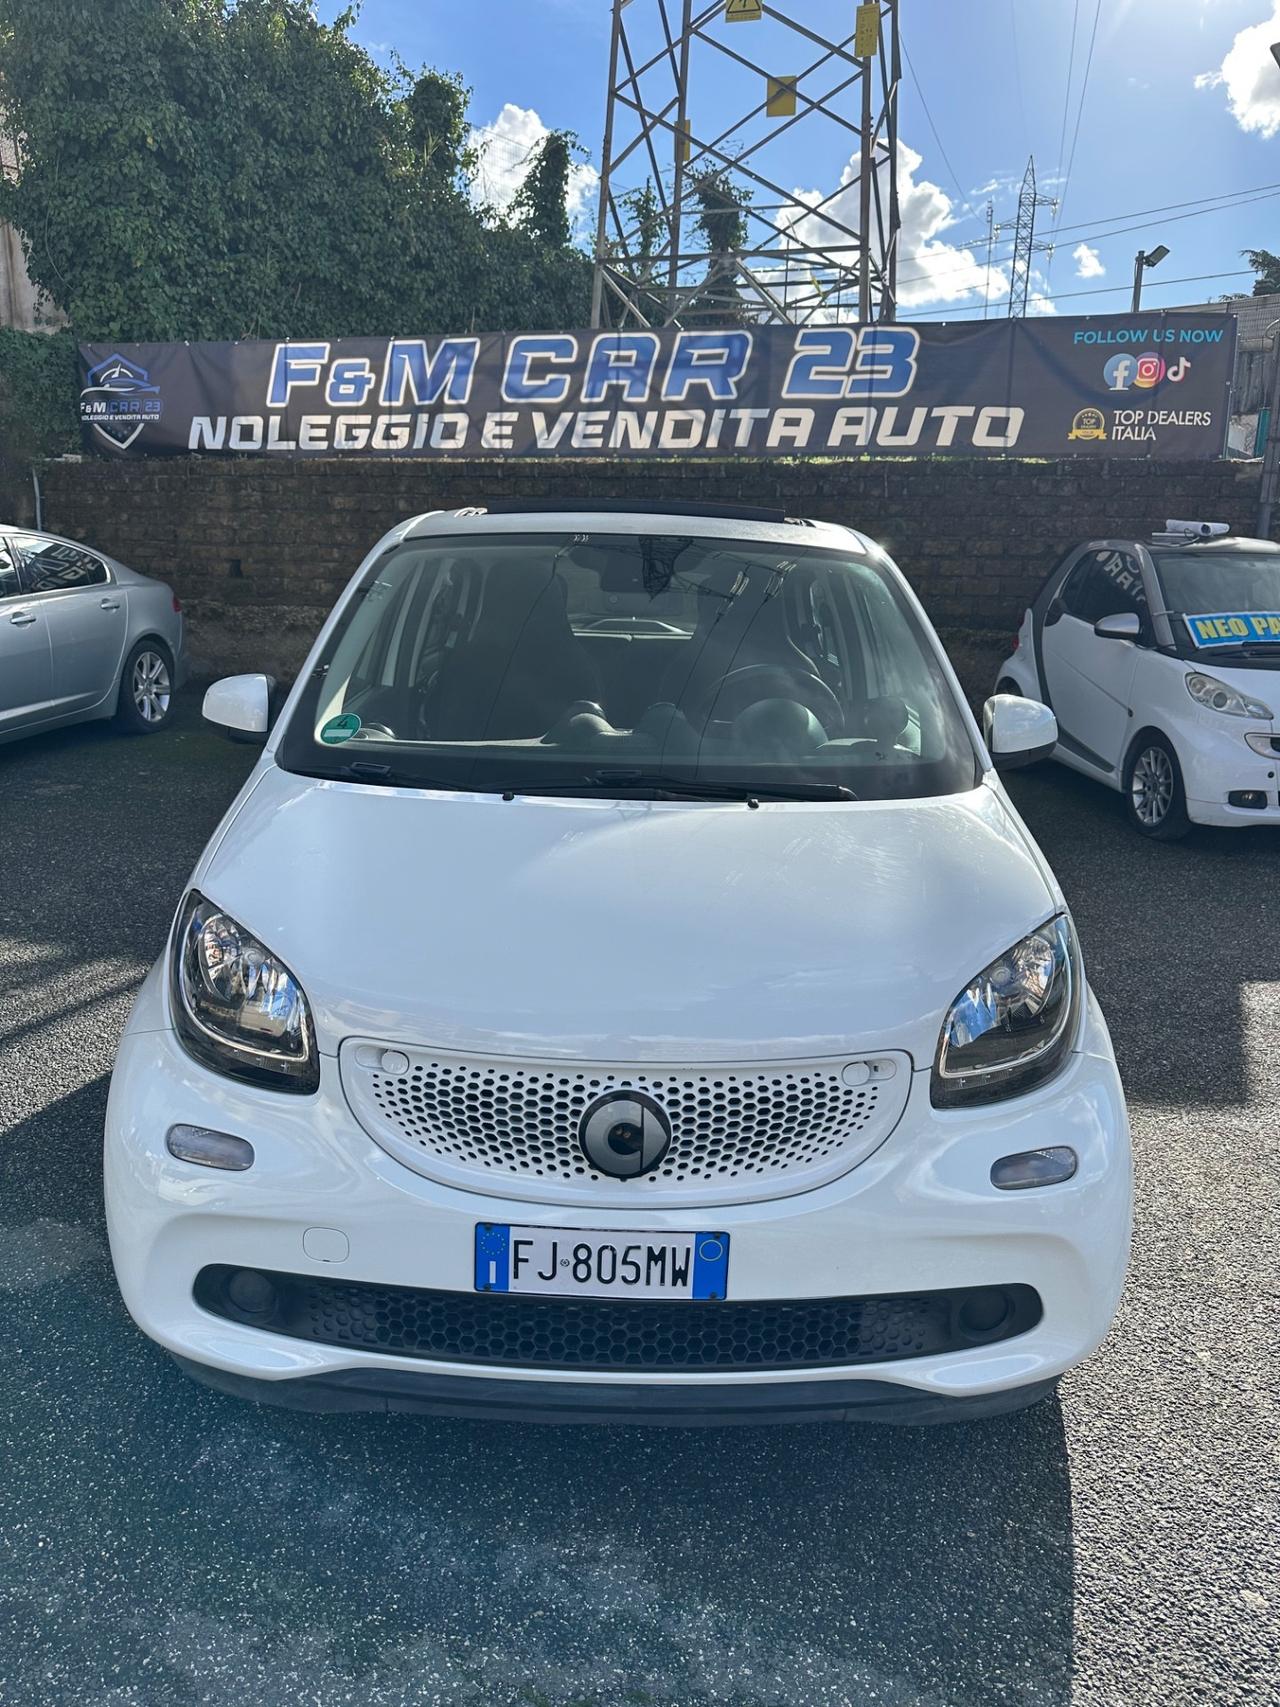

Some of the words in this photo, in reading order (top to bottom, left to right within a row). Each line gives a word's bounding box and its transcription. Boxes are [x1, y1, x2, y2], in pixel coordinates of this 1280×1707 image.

[1074, 330, 1147, 344] FOLLOW
[1153, 329, 1175, 342] US
[1179, 329, 1223, 343] NOW
[267, 338, 480, 407] F&M
[502, 332, 753, 402] CAR
[781, 326, 921, 399] 23
[145, 402, 160, 412] 23
[1113, 410, 1144, 425] TOP
[1147, 410, 1212, 426] DEALERS
[188, 412, 470, 451] NOLEGGIO
[481, 411, 520, 450] E
[531, 406, 815, 450] VENDITA
[826, 405, 1025, 448] AUTO
[1112, 426, 1156, 440] ITALIA
[1195, 617, 1249, 639] NEO
